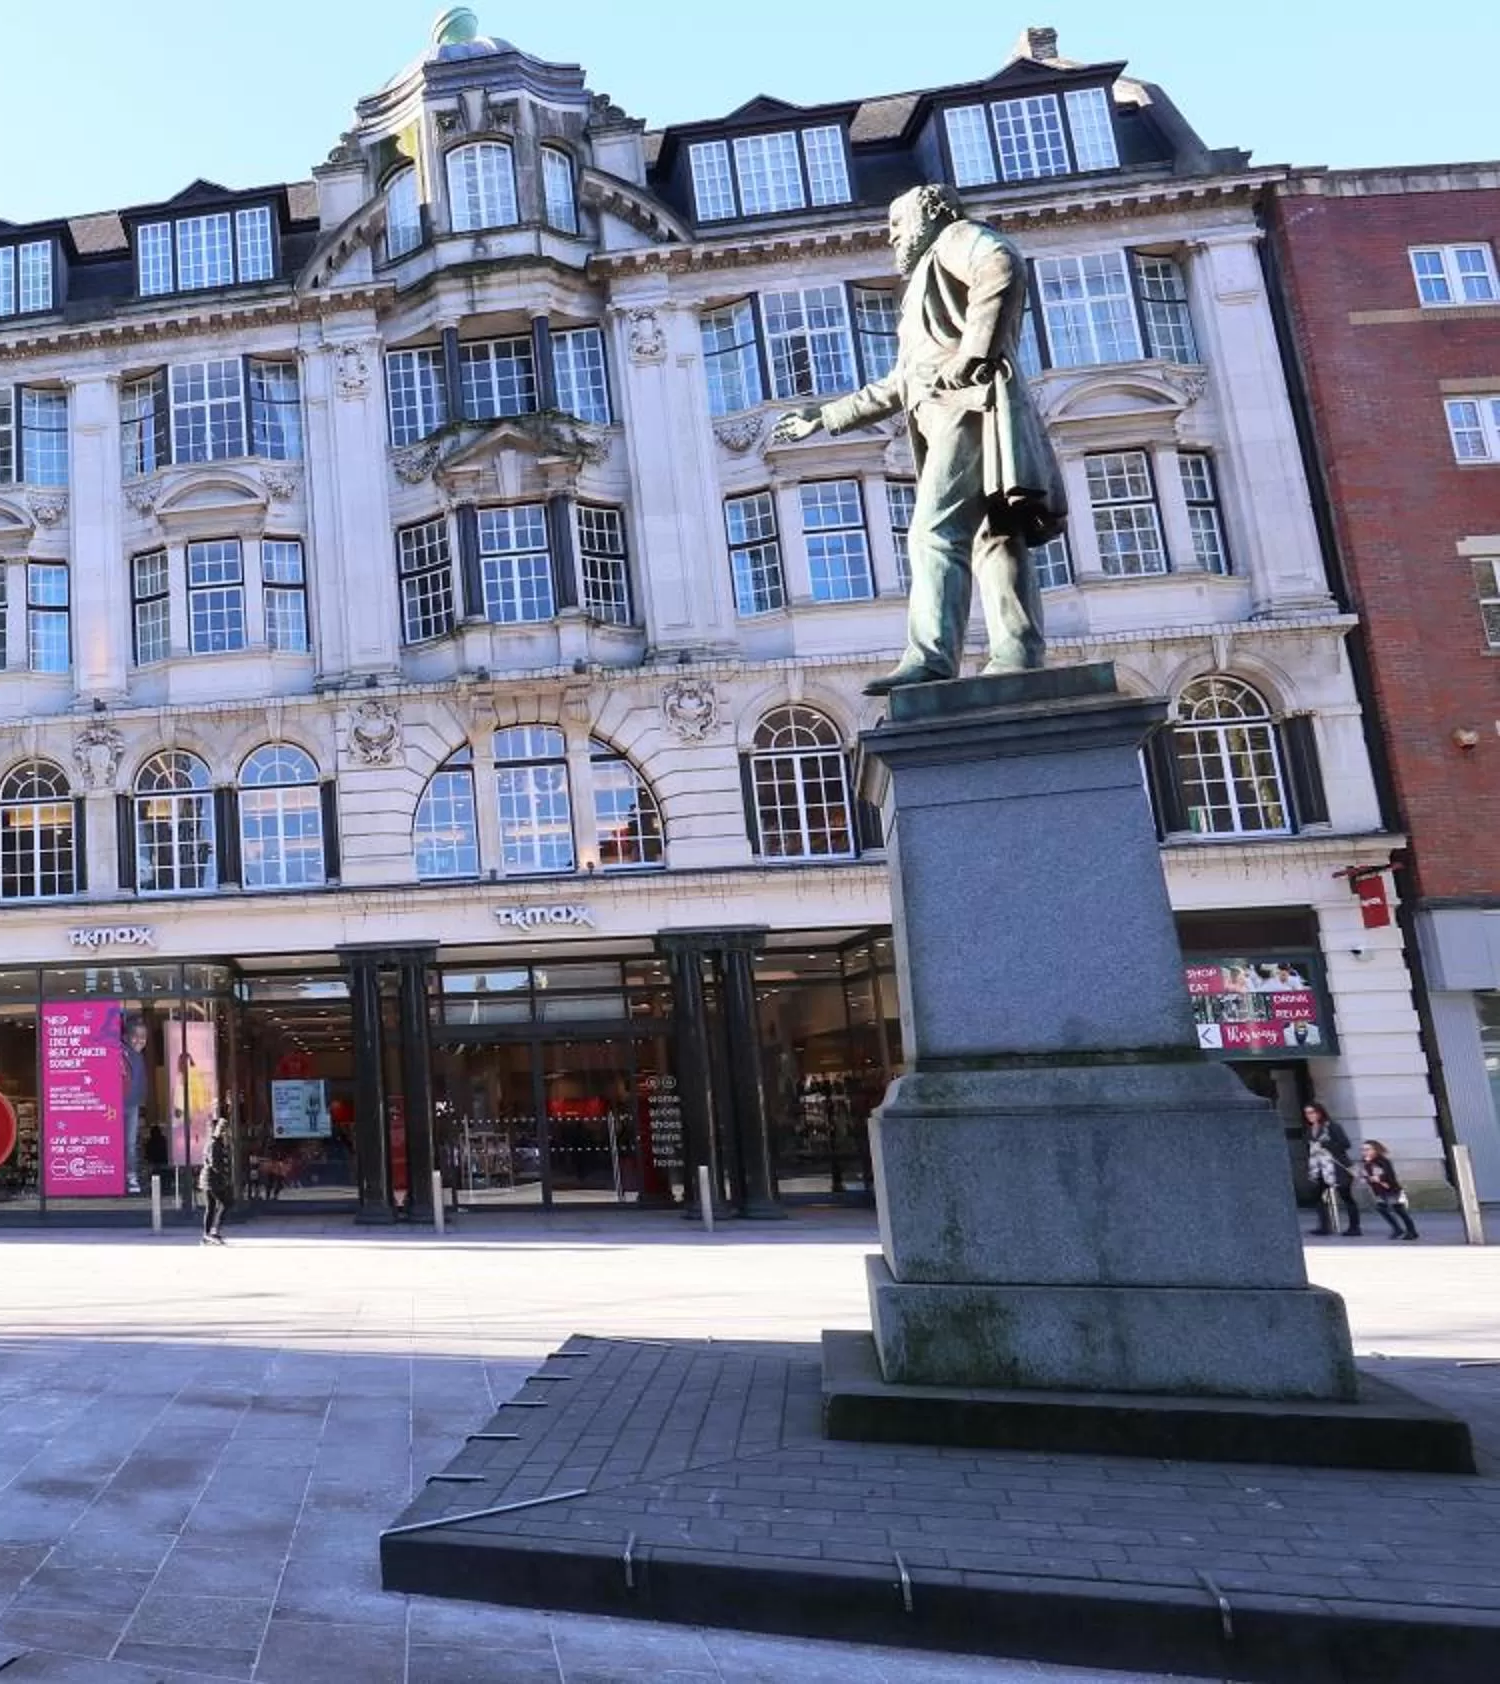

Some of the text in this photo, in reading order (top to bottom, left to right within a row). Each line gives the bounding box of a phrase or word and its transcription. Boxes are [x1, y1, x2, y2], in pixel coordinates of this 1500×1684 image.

[1186, 968, 1217, 979] SHOP
[1189, 983, 1209, 993] EAT
[1272, 994, 1309, 1003] DRINK
[1275, 1009, 1312, 1018] RELAX
[1227, 1025, 1278, 1045] this way
[71, 1047, 107, 1056] CANCER
